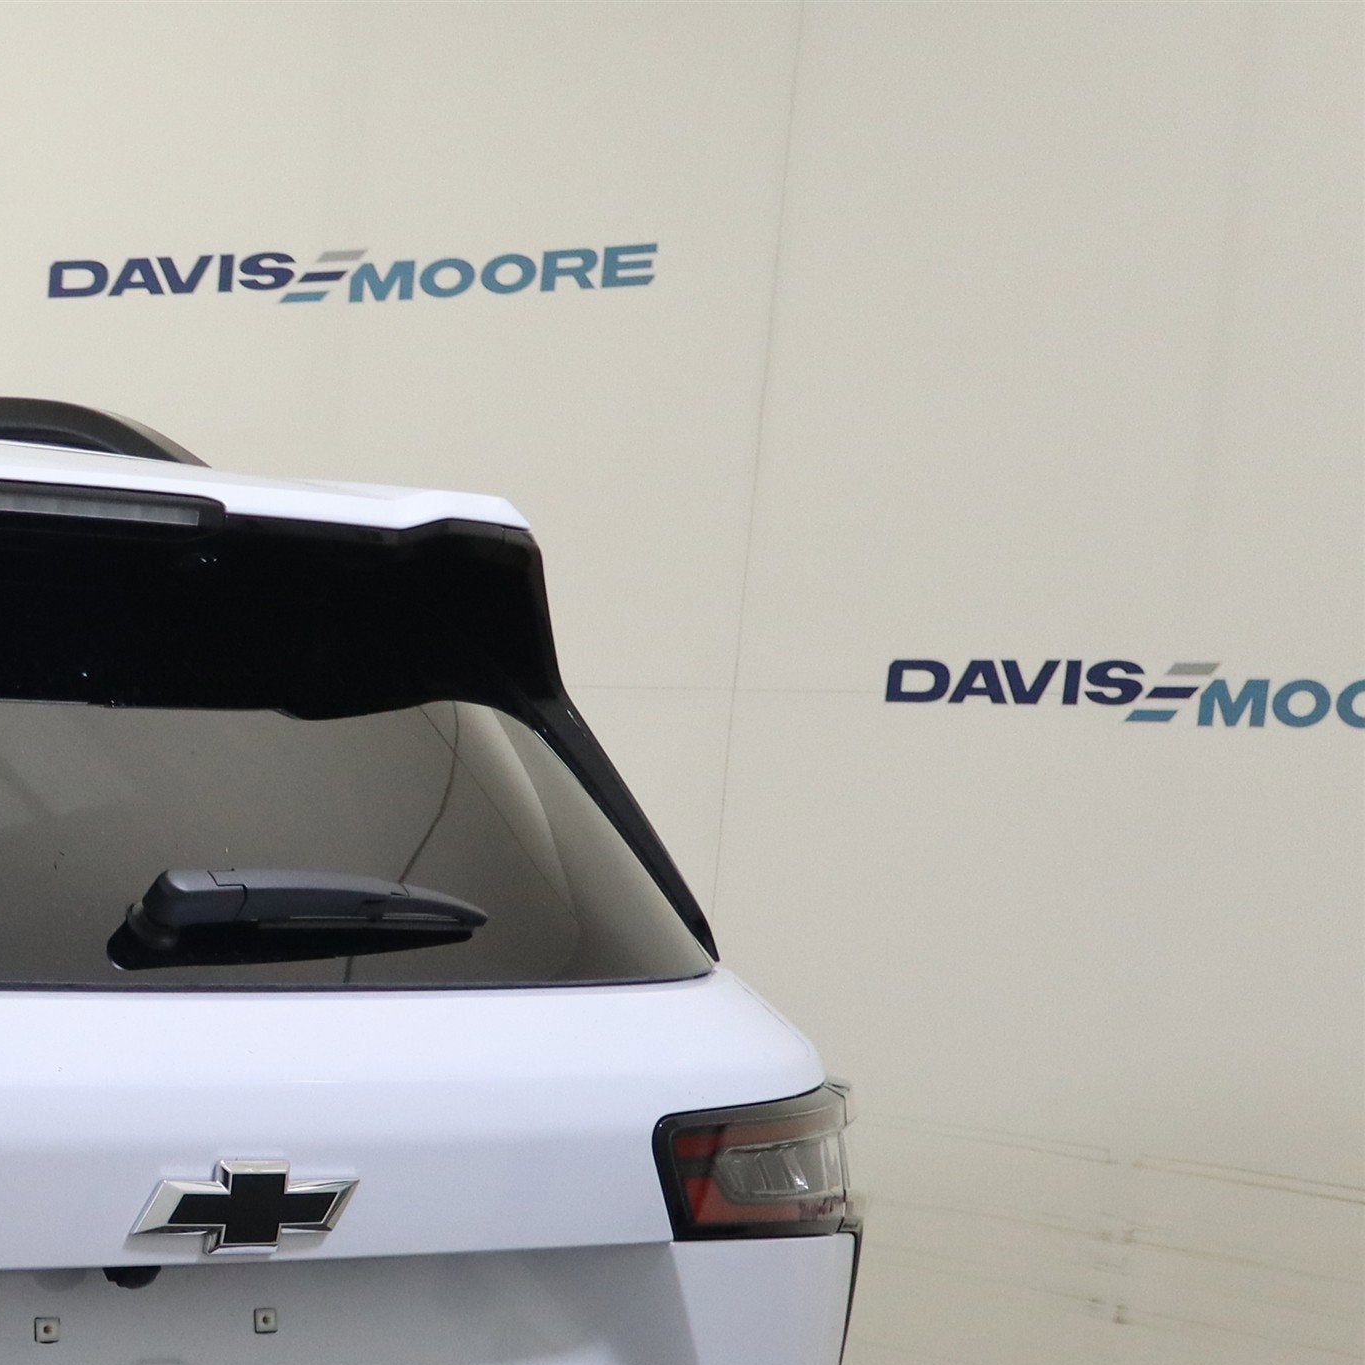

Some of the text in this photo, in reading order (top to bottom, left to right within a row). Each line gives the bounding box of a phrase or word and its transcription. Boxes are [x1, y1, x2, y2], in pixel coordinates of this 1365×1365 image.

[47, 243, 658, 303] DAVIS MOORE
[885, 659, 1146, 706] DAVIS
